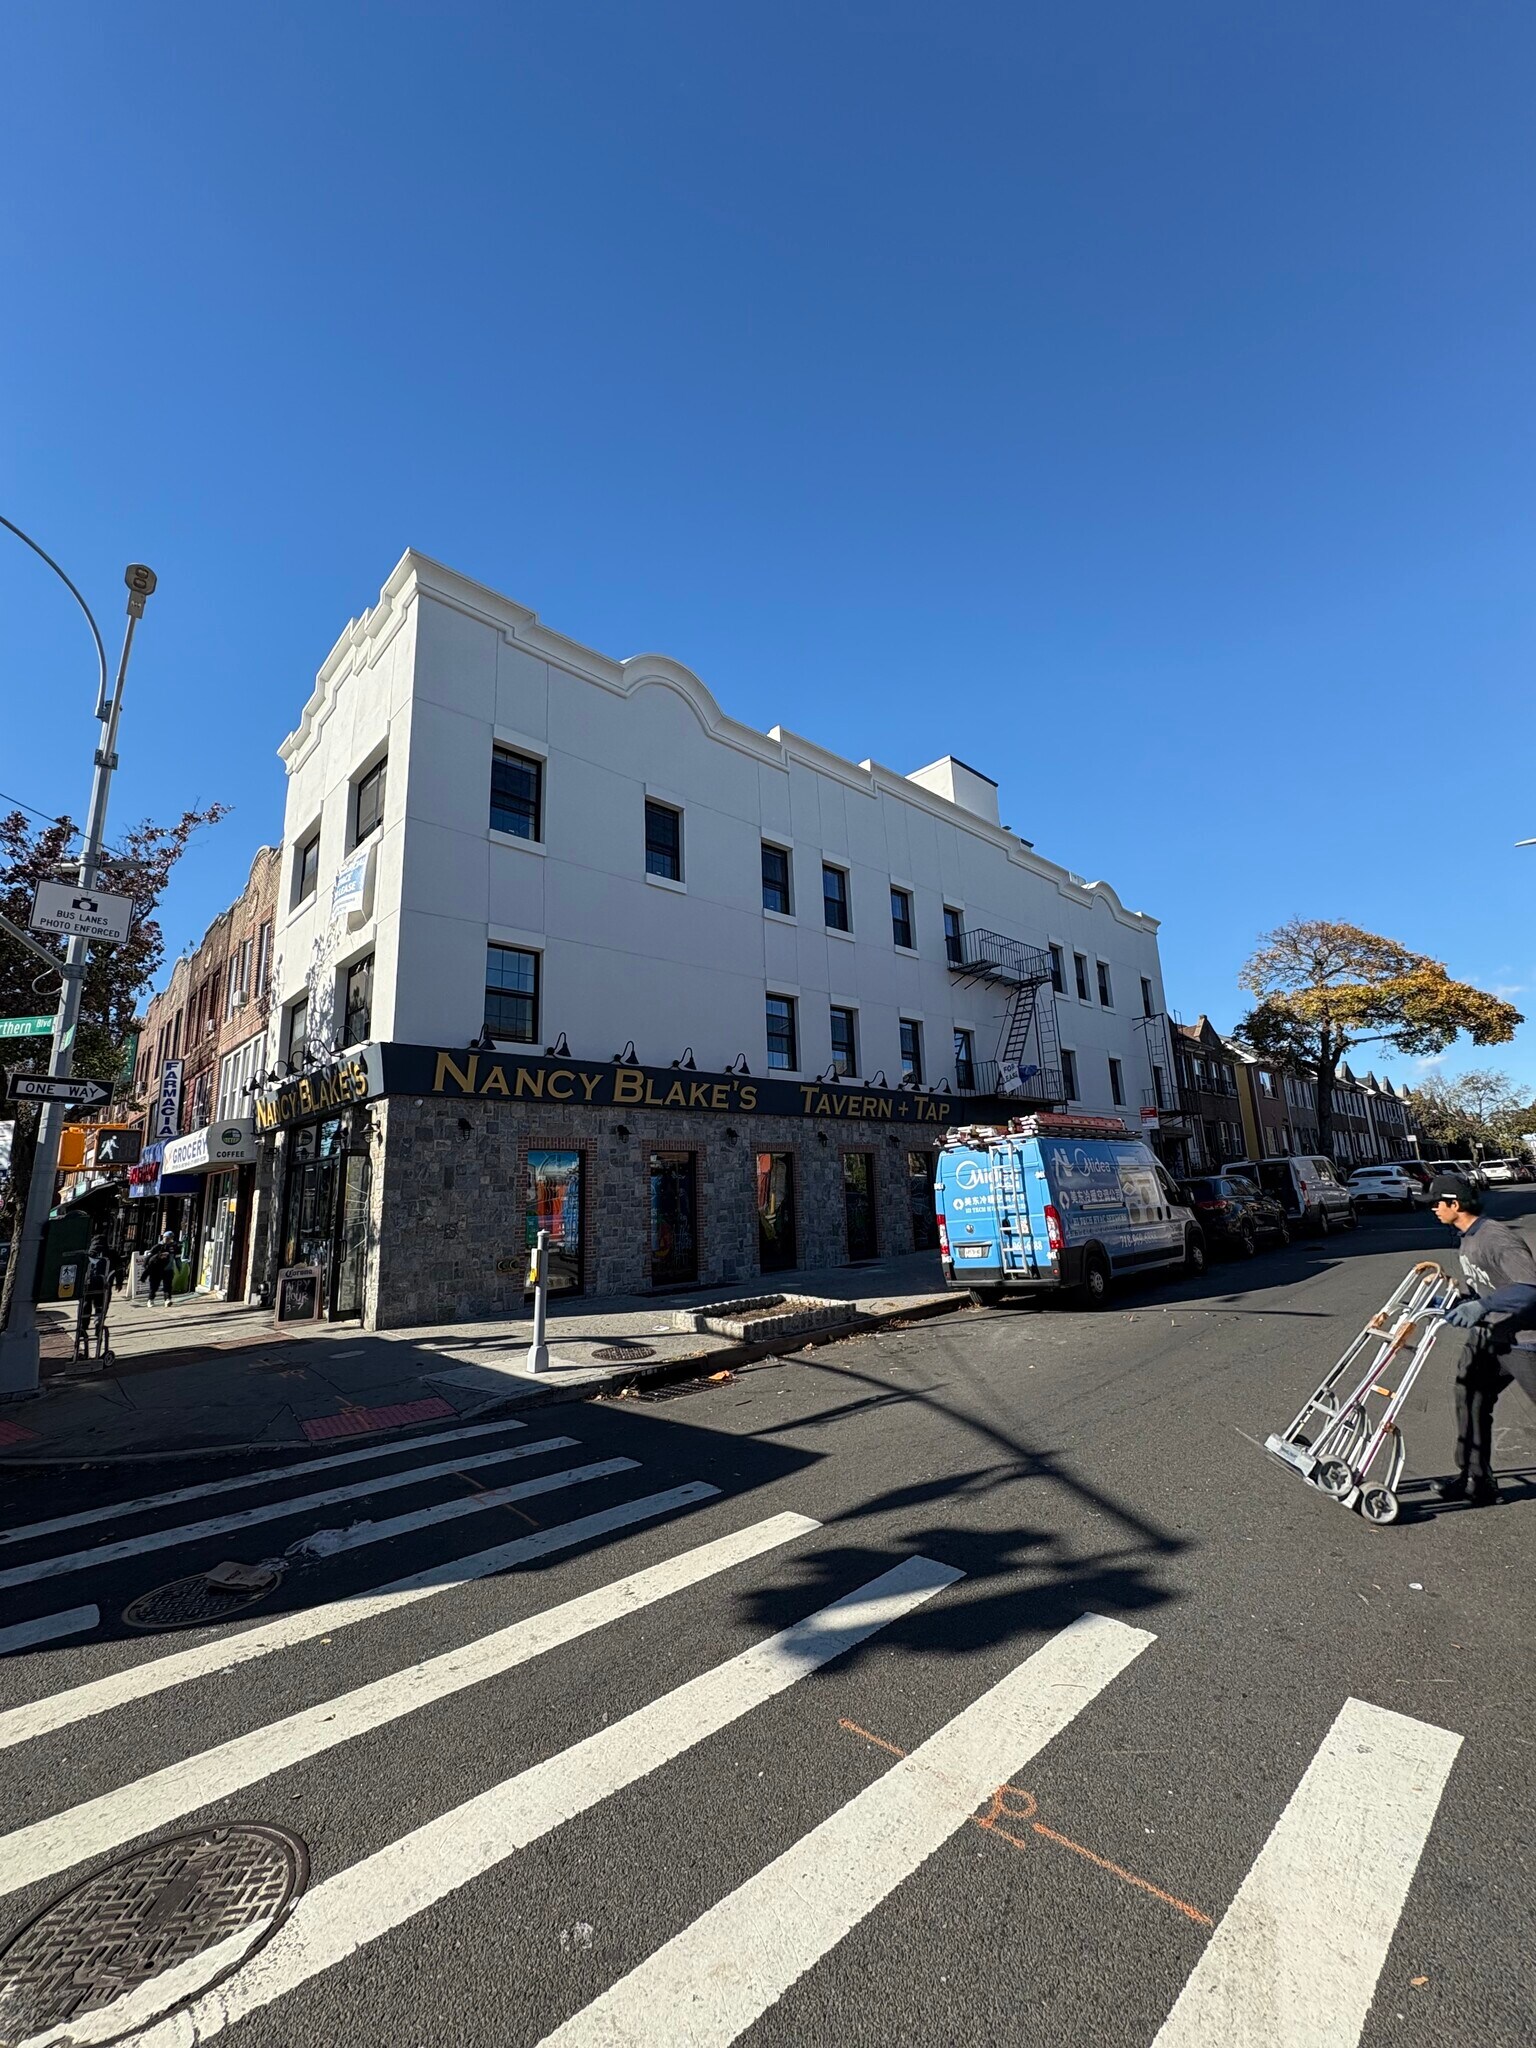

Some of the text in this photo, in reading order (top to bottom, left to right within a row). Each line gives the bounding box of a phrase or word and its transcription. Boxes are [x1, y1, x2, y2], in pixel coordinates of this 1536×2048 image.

[56, 909, 108, 926] BUS LANES
[40, 917, 120, 938] PHOTO ENFORCED
[36, 1018, 52, 1028] Blvd
[25, 1082, 99, 1098] ONE WAY
[432, 1051, 604, 1101] NANCY
[613, 1068, 758, 1110] BLAKE'S
[800, 1085, 894, 1118] TAVERN
[914, 1095, 951, 1121] TAP
[159, 1061, 180, 1135] FARMACIA
[256, 1061, 369, 1129] NANCY BLAKE'S
[172, 1137, 208, 1164] GROCERY
[216, 1150, 245, 1158] COFFEE
[285, 1269, 313, 1278] Corona
[285, 1291, 309, 1303] HOUR
[285, 1302, 304, 1313] 3-7
